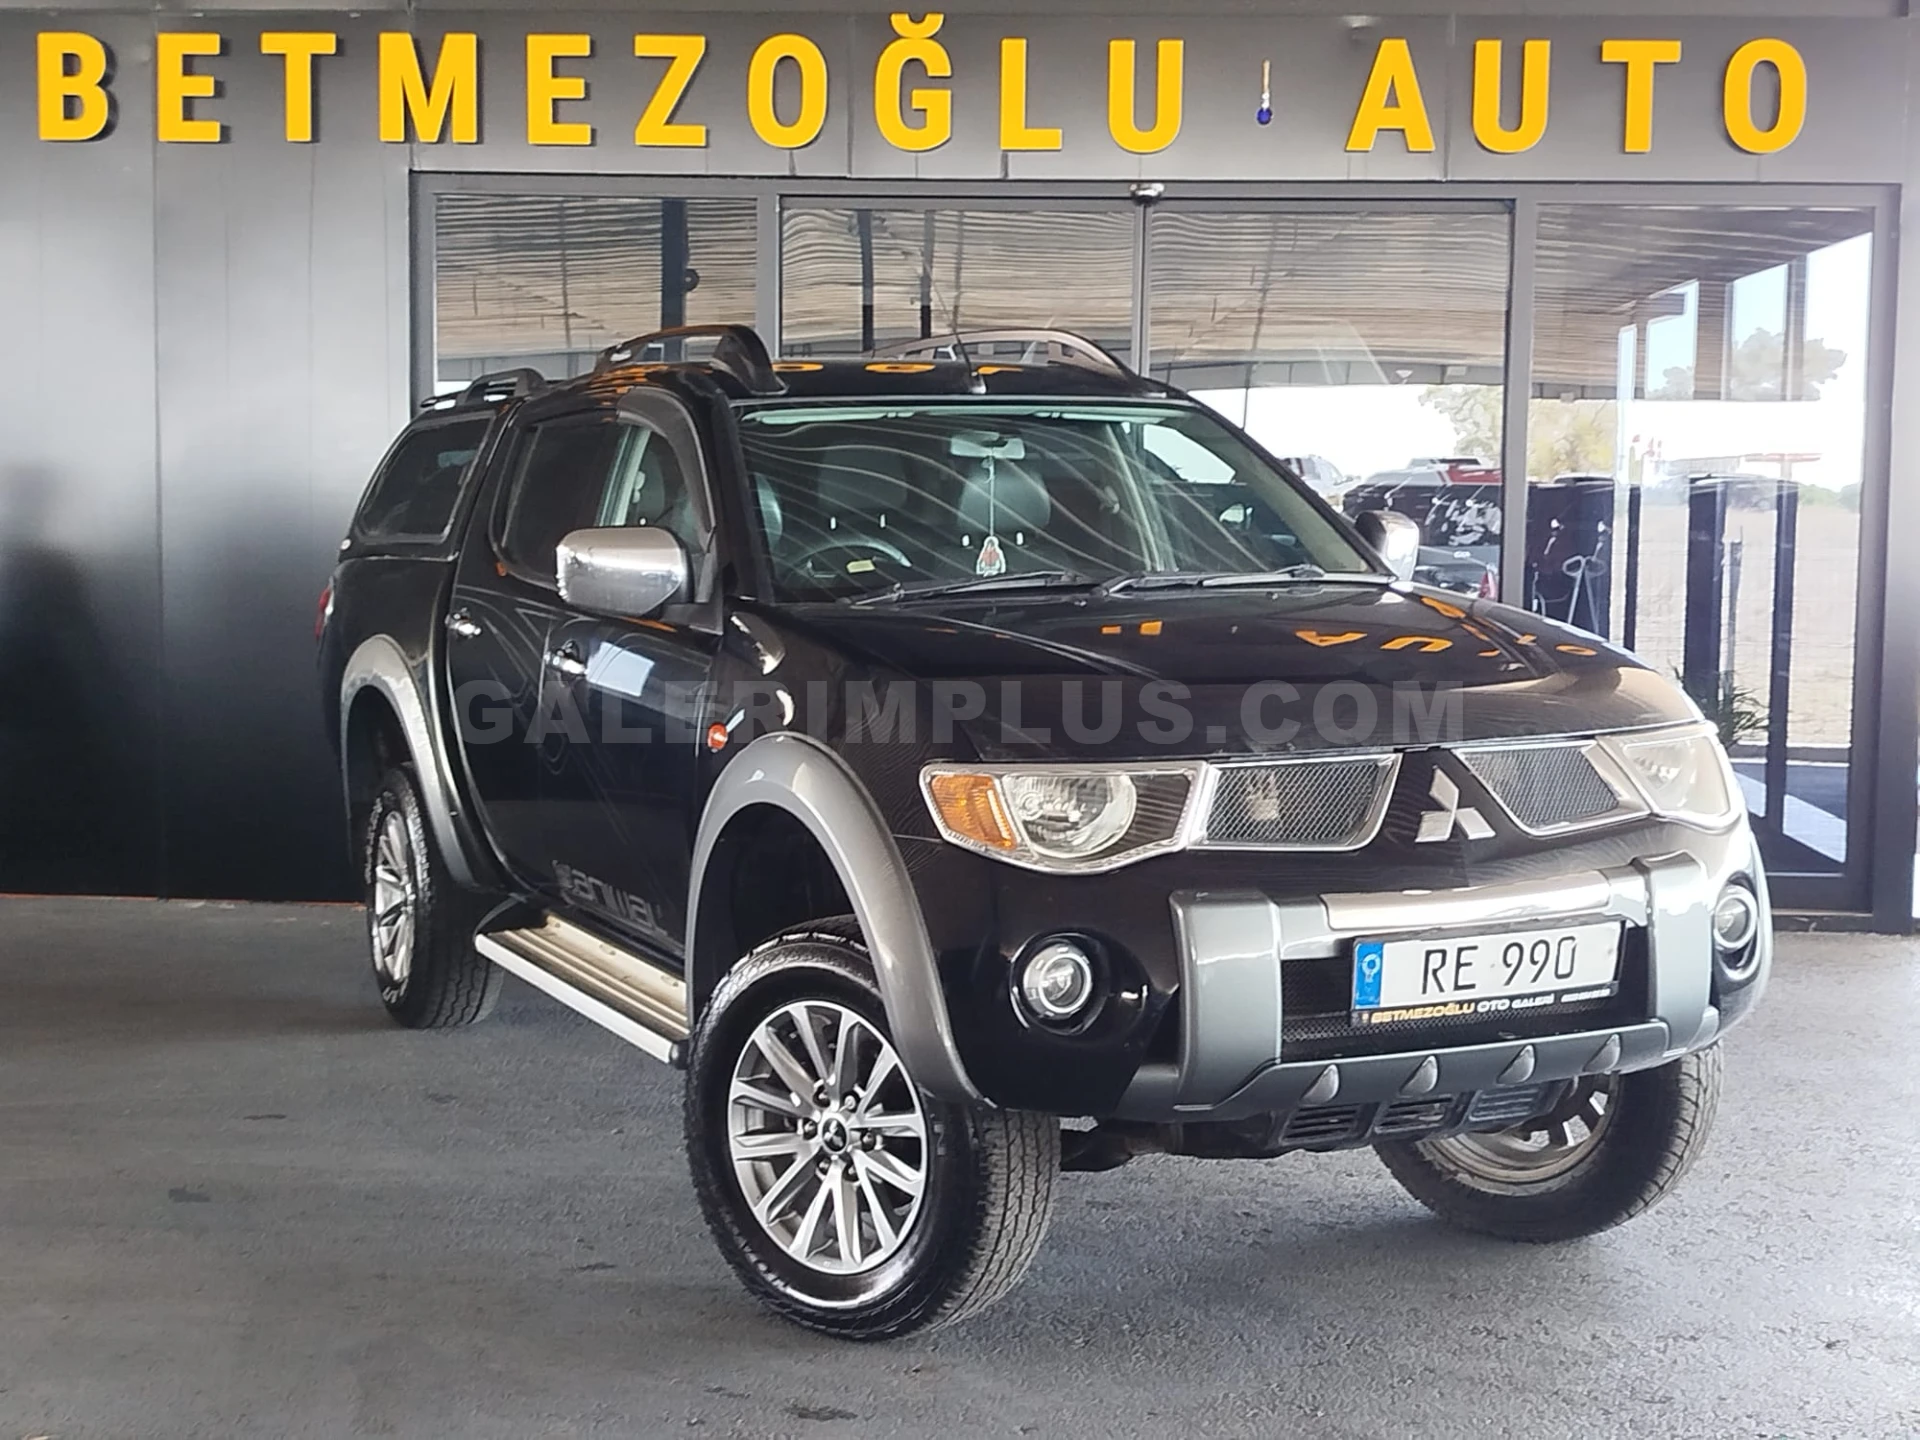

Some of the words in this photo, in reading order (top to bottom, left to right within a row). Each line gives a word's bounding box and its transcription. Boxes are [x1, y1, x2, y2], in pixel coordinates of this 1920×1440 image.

[37, 13, 1184, 153] BETMEZOĞLU
[1346, 38, 1808, 154] AUTO
[1421, 946, 1478, 995] RE
[1502, 936, 1577, 987] 990
